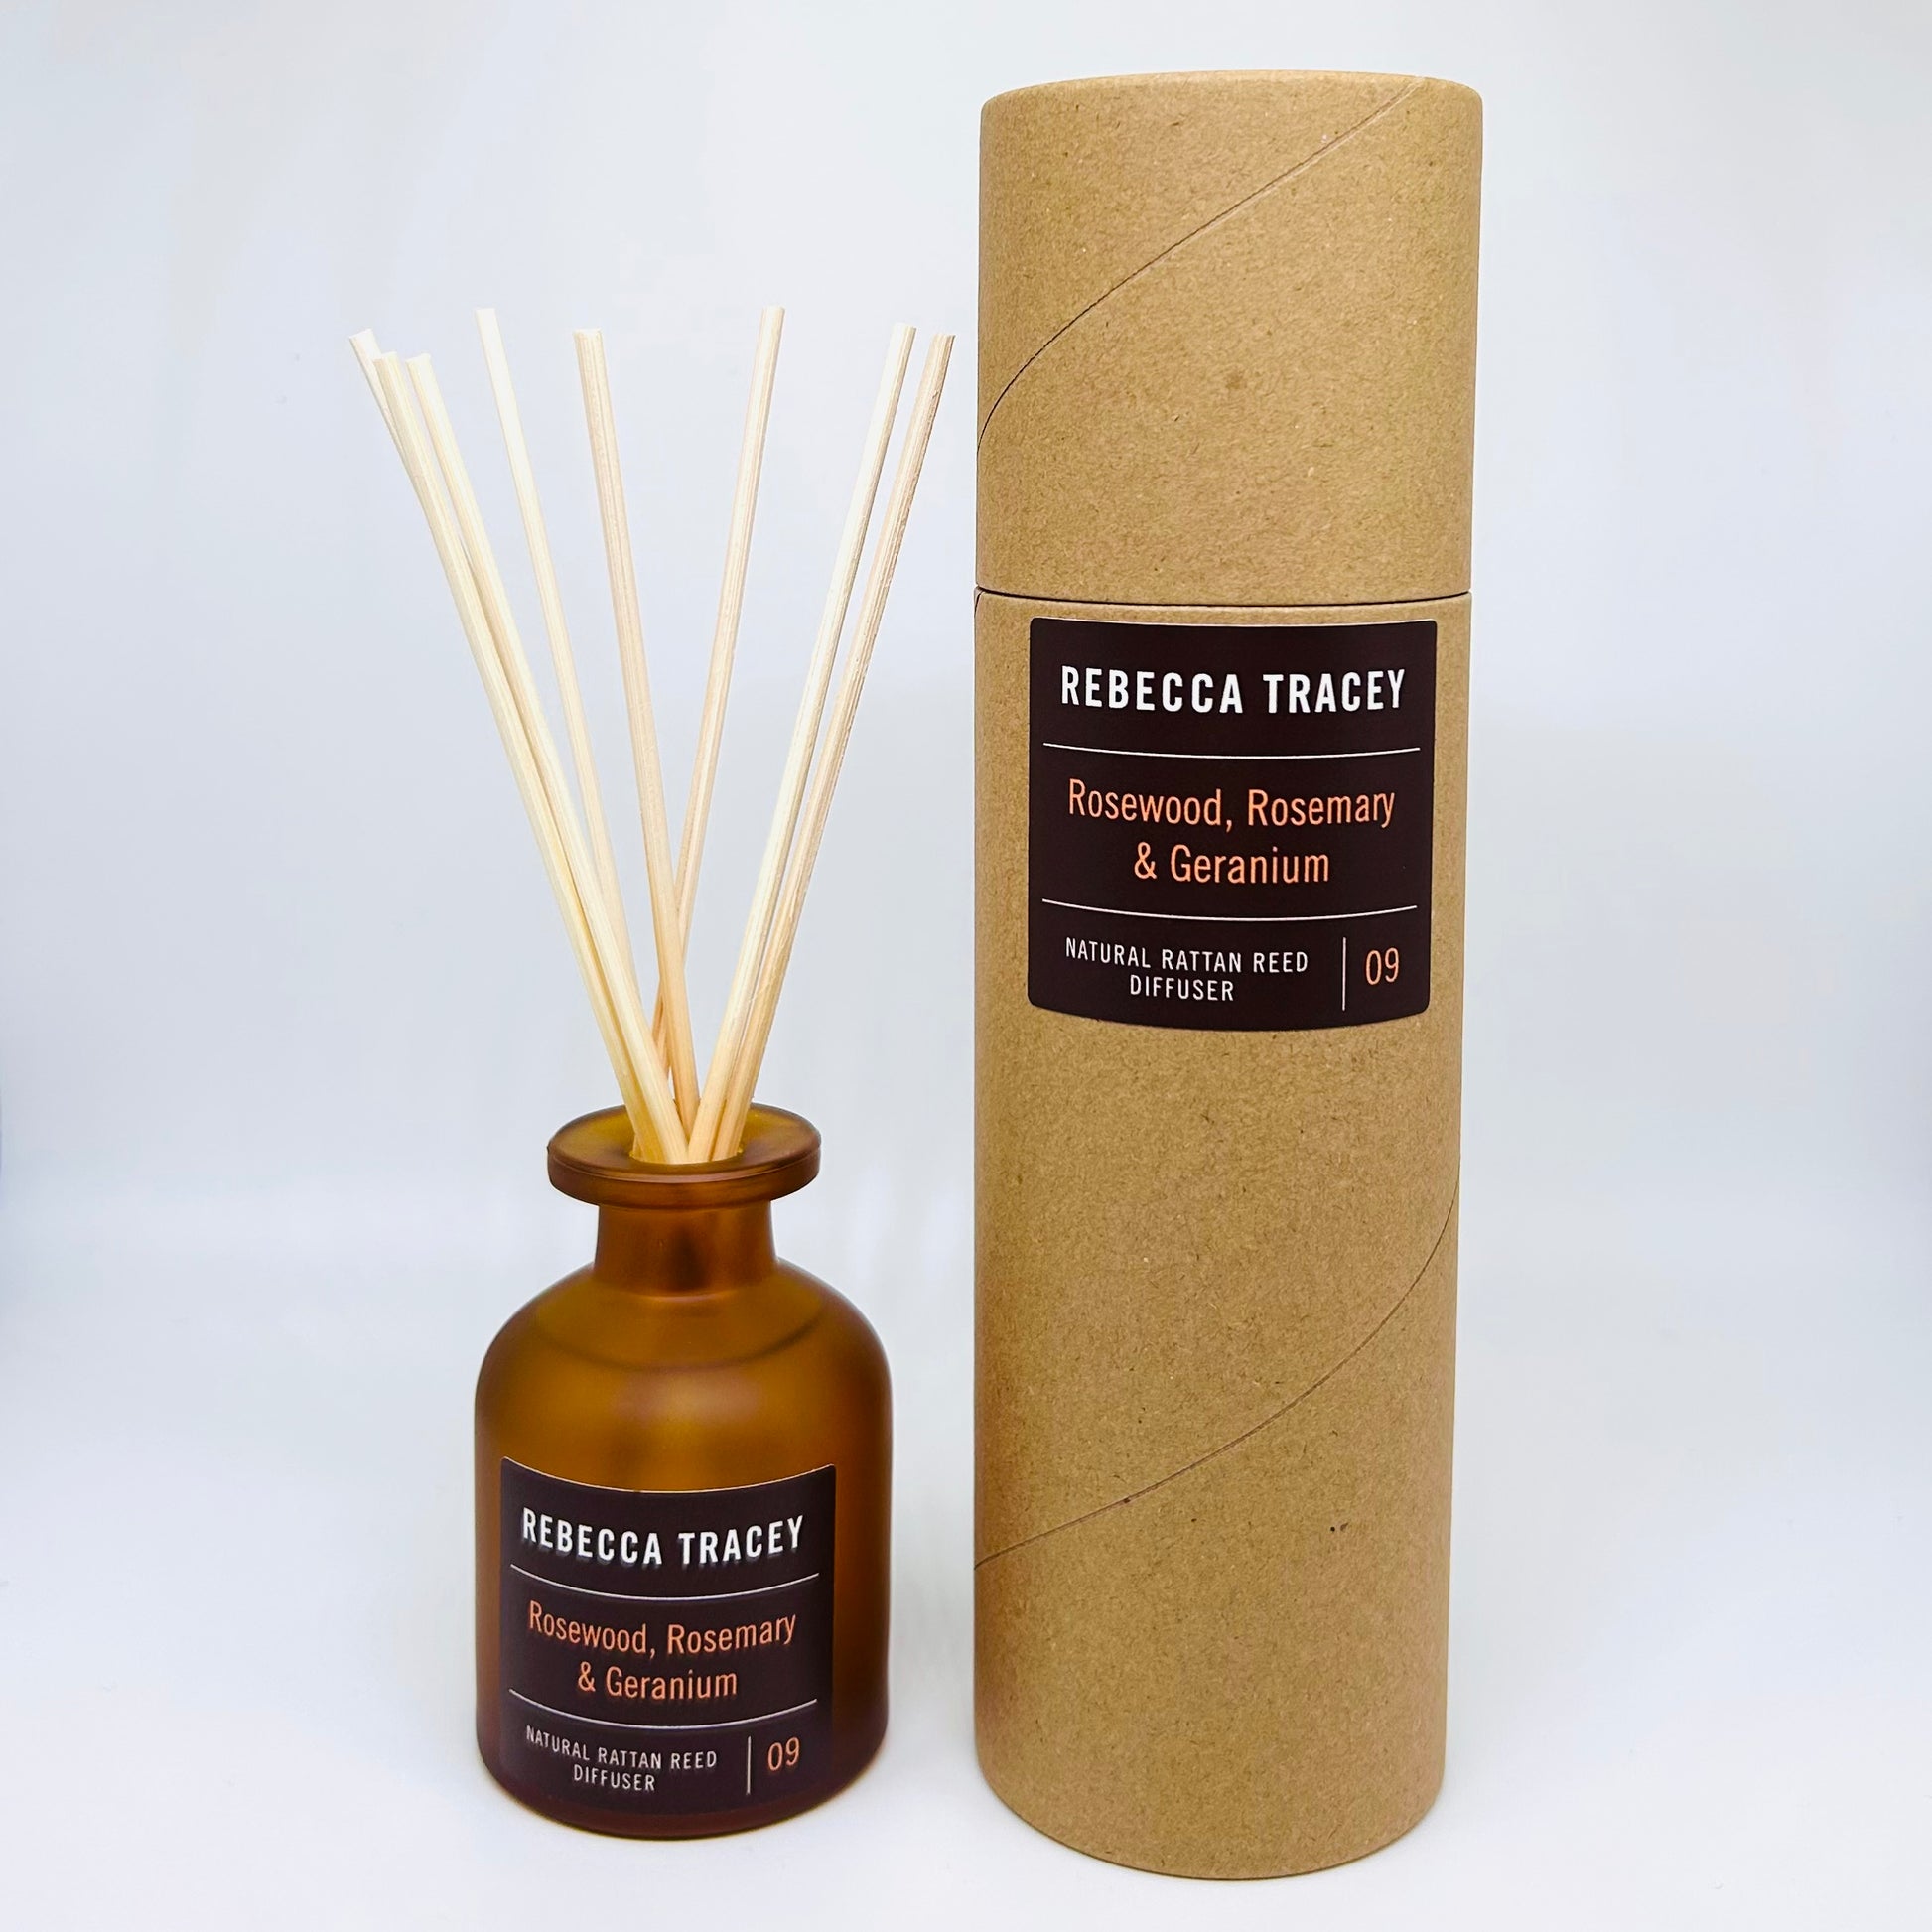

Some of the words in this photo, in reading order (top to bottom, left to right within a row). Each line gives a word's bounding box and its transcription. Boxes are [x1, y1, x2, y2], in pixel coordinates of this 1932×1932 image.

[1062, 666, 1243, 713] REBECCA
[1262, 669, 1405, 713] TRACEY
[1069, 778, 1233, 832] Rosewood,
[1248, 788, 1395, 828] Rosemary
[1134, 841, 1158, 880] &
[1170, 845, 1329, 884] Geranium
[1065, 936, 1152, 969] NATURAL
[1162, 948, 1242, 973] RATTAN
[1253, 951, 1308, 973] REED
[1365, 947, 1400, 986] 09
[1130, 974, 1234, 1002] DIFFUSER
[522, 1507, 662, 1565] REBECCA
[678, 1514, 803, 1565] TRACEY
[529, 1599, 657, 1658] Rosewood,
[667, 1614, 796, 1654] Rosemary
[577, 1661, 596, 1692] &
[606, 1666, 737, 1700] Geranium
[526, 1725, 591, 1761] NATURAL
[598, 1746, 661, 1769] RATTAN
[670, 1750, 717, 1770] REED
[767, 1737, 800, 1771] 09
[574, 1767, 656, 1791] DIFFUSER
